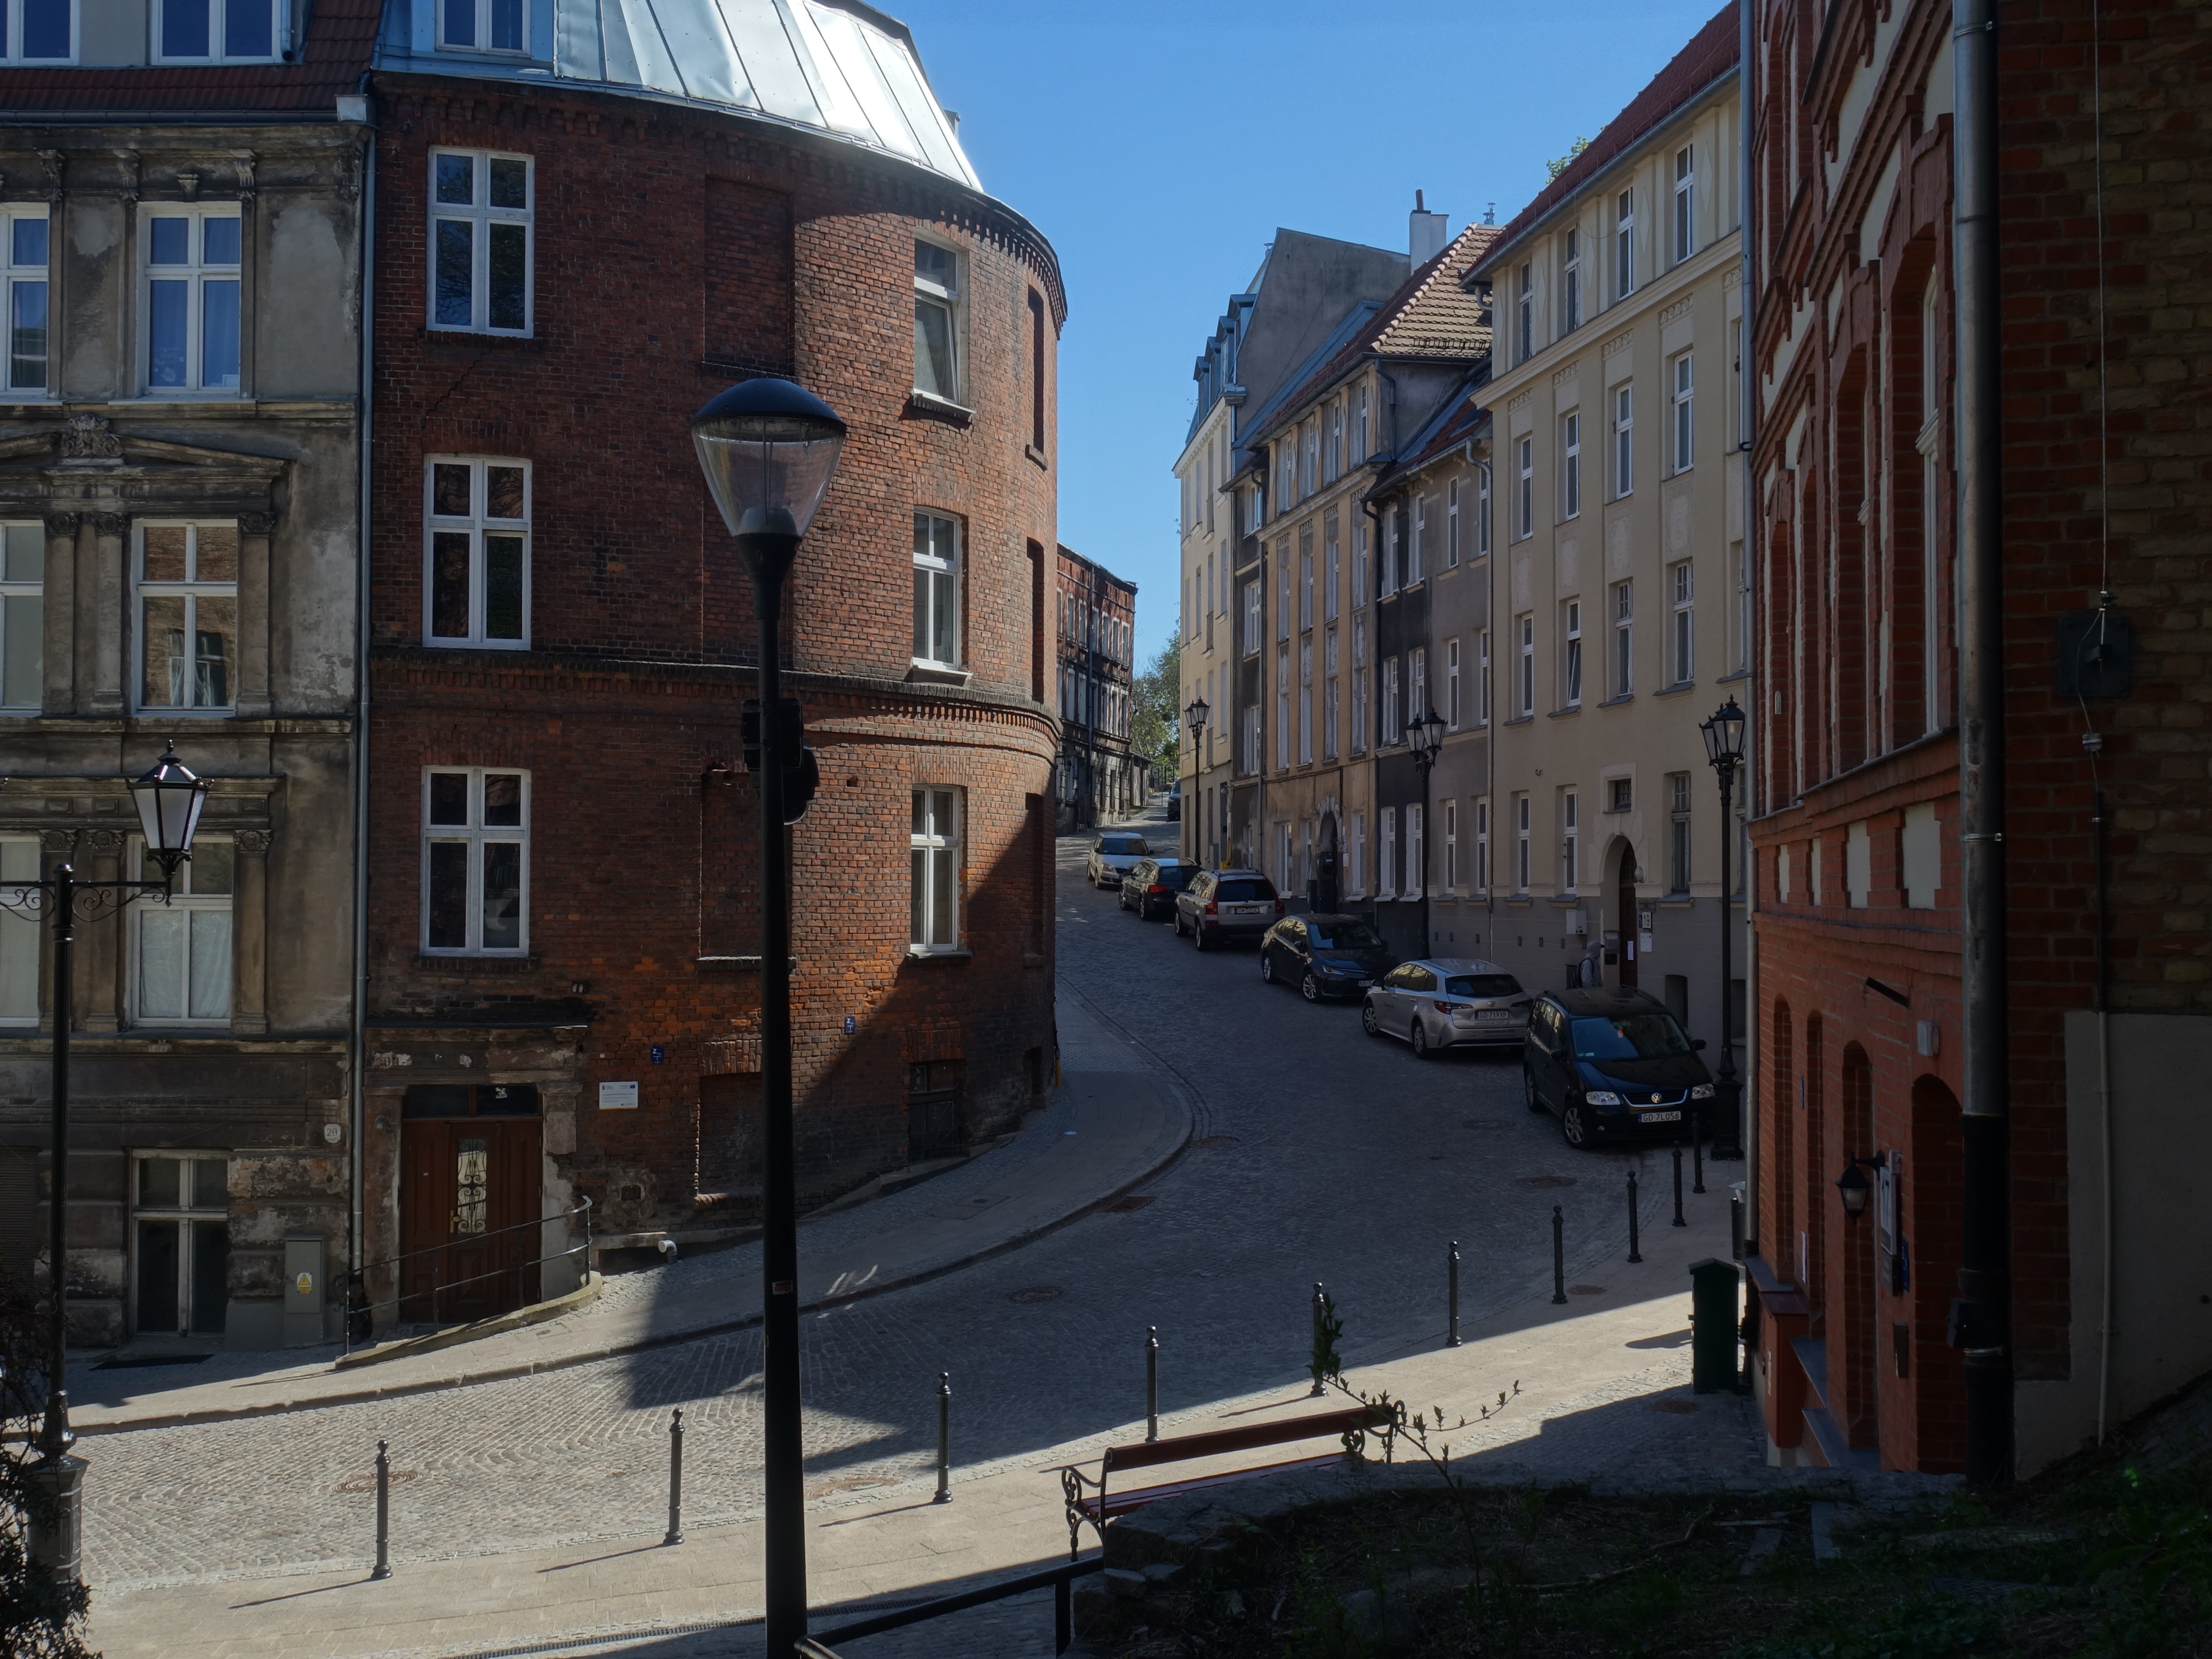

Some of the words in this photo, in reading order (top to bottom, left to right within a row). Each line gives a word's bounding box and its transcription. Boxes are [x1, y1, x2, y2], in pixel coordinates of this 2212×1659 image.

[1644, 914, 1650, 926] 19
[1656, 1112, 1679, 1121] 7L056
[327, 1128, 338, 1136] 28
